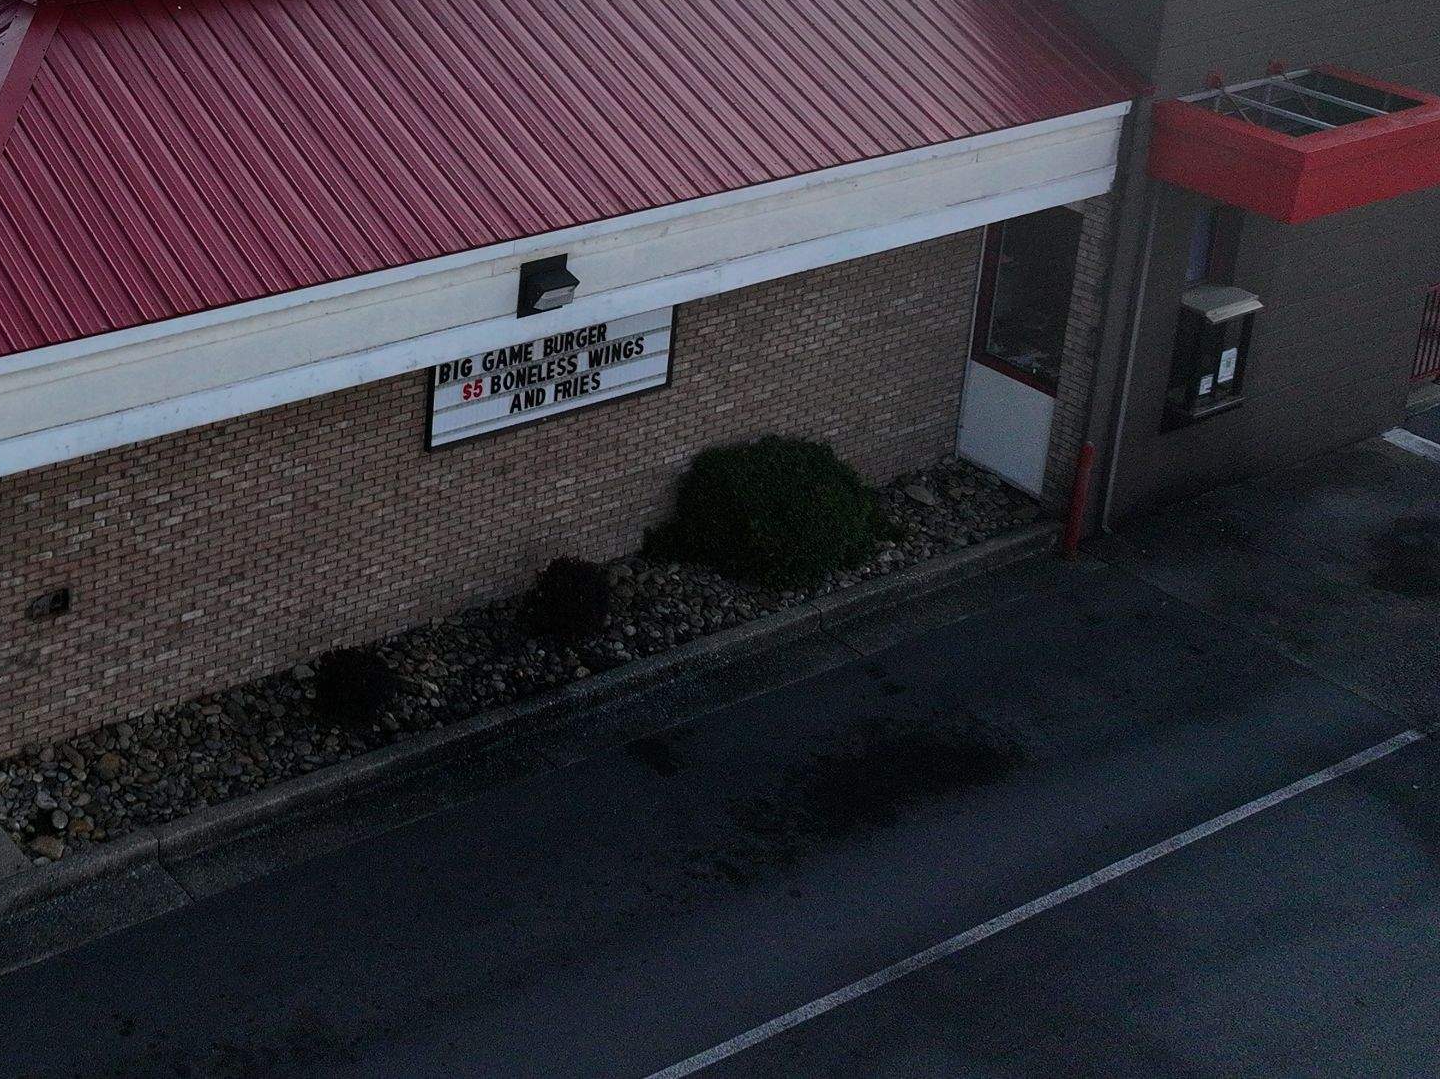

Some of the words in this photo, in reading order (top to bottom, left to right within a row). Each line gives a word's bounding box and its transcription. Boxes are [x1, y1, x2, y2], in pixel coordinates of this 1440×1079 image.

[439, 359, 473, 385] BIG
[482, 343, 533, 372] GAME
[543, 323, 608, 357] BURGER
[462, 378, 484, 401] $5
[490, 354, 578, 395] BONELESS
[588, 337, 645, 368] WINGS
[509, 388, 546, 414] AND
[553, 372, 601, 402] FRIES
